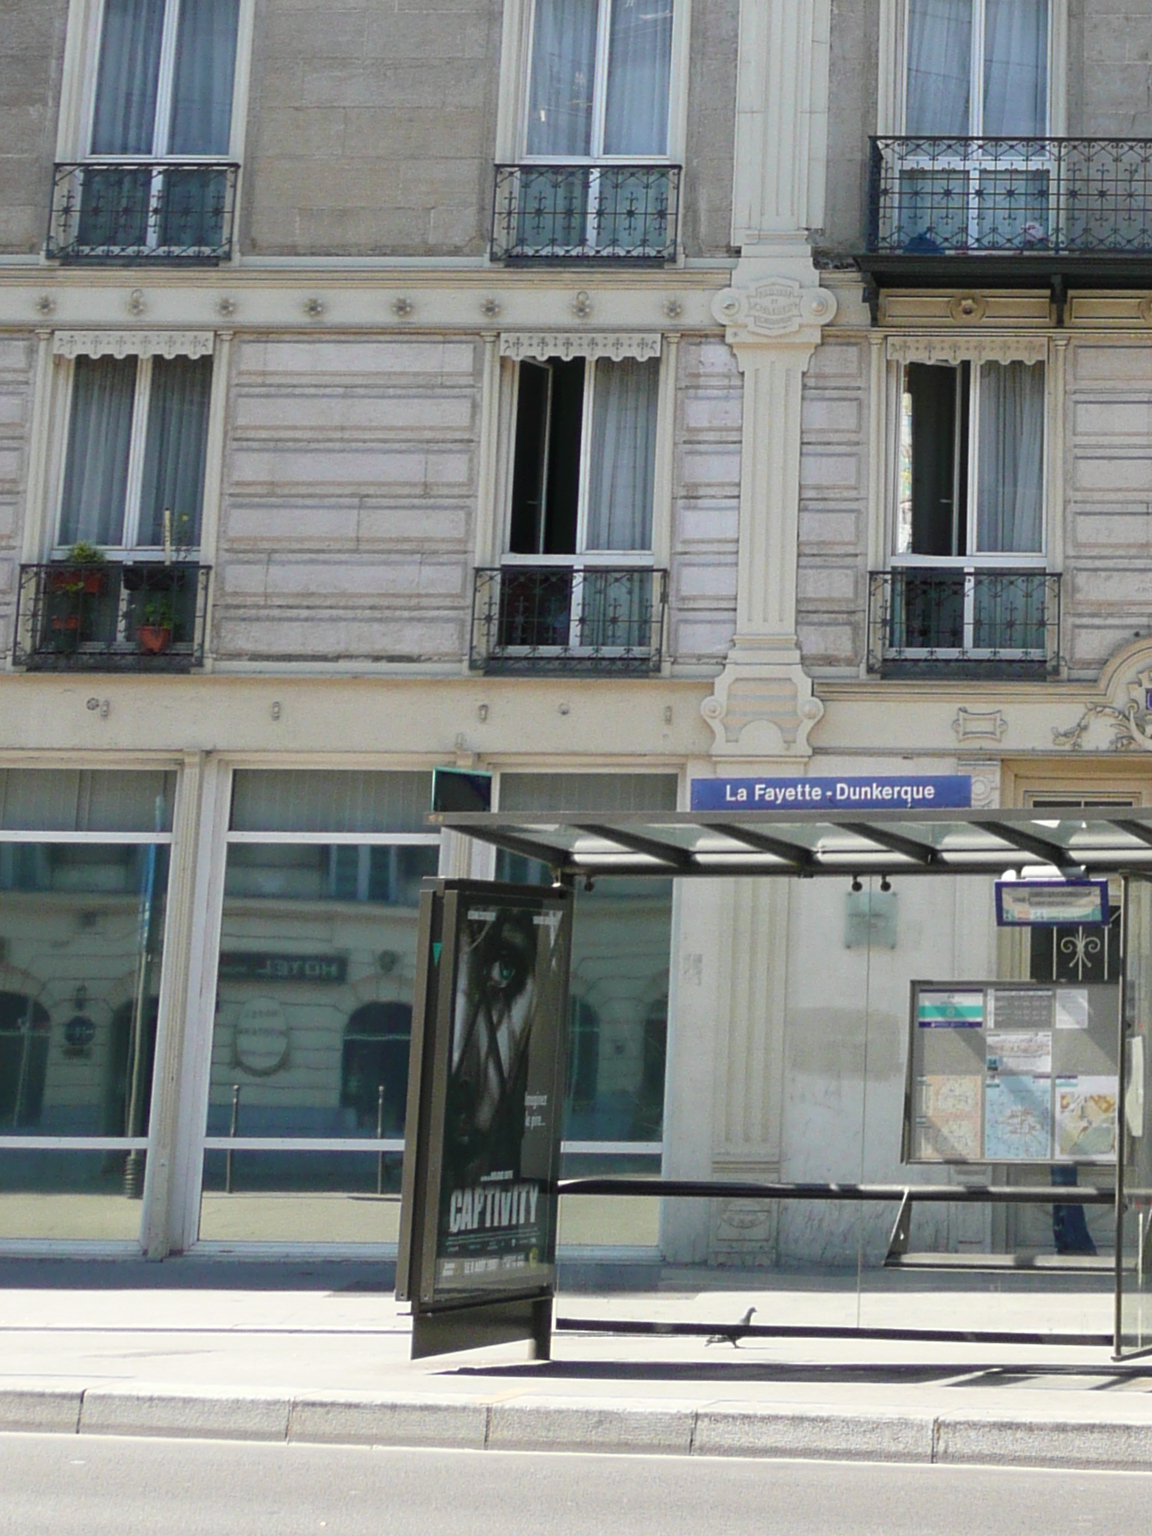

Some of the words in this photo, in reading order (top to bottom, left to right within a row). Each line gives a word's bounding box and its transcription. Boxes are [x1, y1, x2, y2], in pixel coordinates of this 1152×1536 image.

[726, 784, 747, 801] La
[754, 783, 822, 804] Fayette
[836, 782, 935, 807] Dunkerque
[448, 1183, 540, 1234] CAPTIVITY
